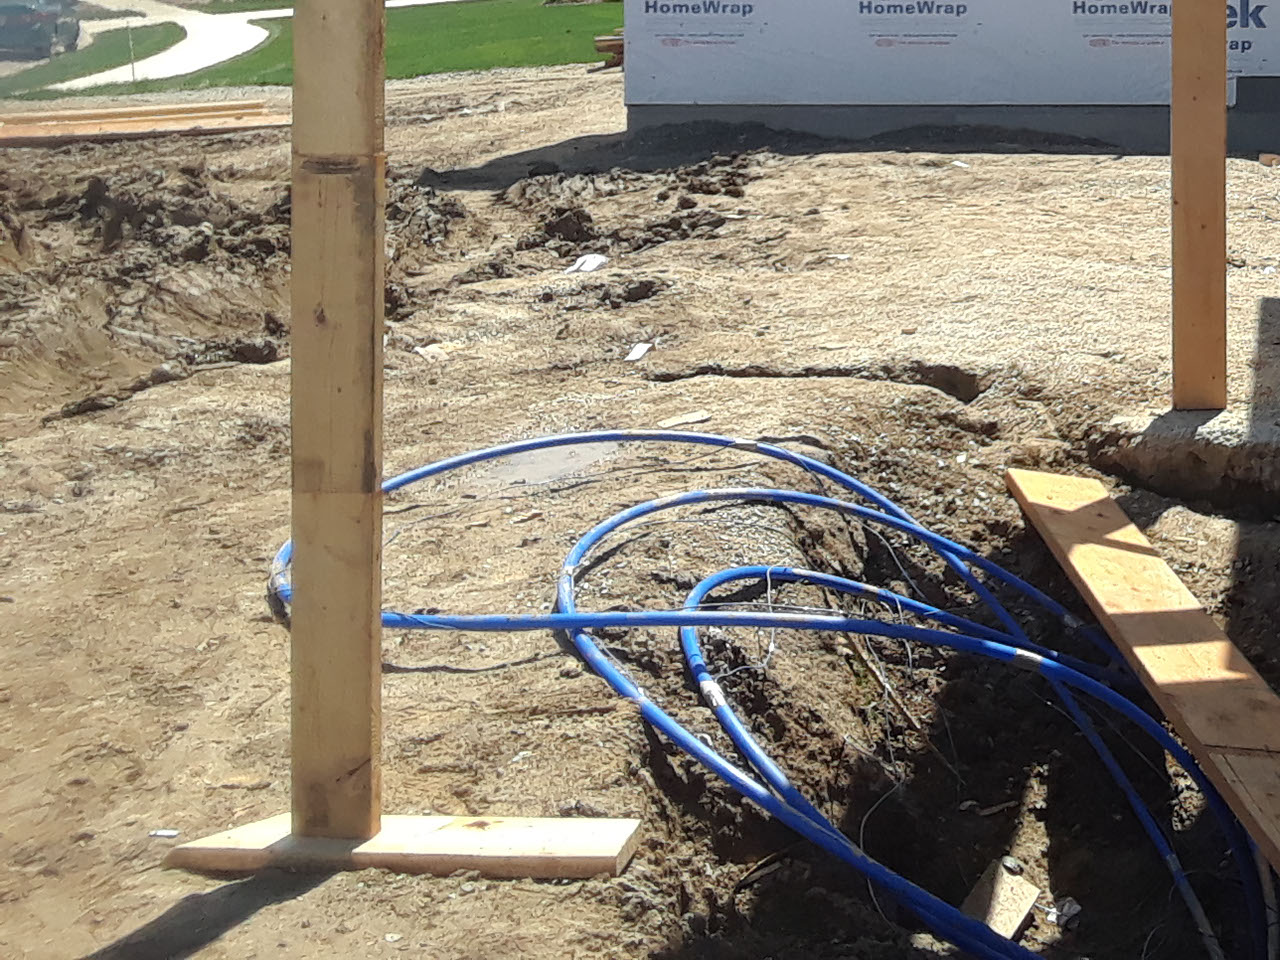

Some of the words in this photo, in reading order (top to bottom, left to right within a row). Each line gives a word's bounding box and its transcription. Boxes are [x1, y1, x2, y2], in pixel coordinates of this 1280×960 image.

[645, 1, 754, 16] HomeWrap
[859, 1, 967, 17] HomeWrap
[1072, 1, 1172, 16] HomeWra
